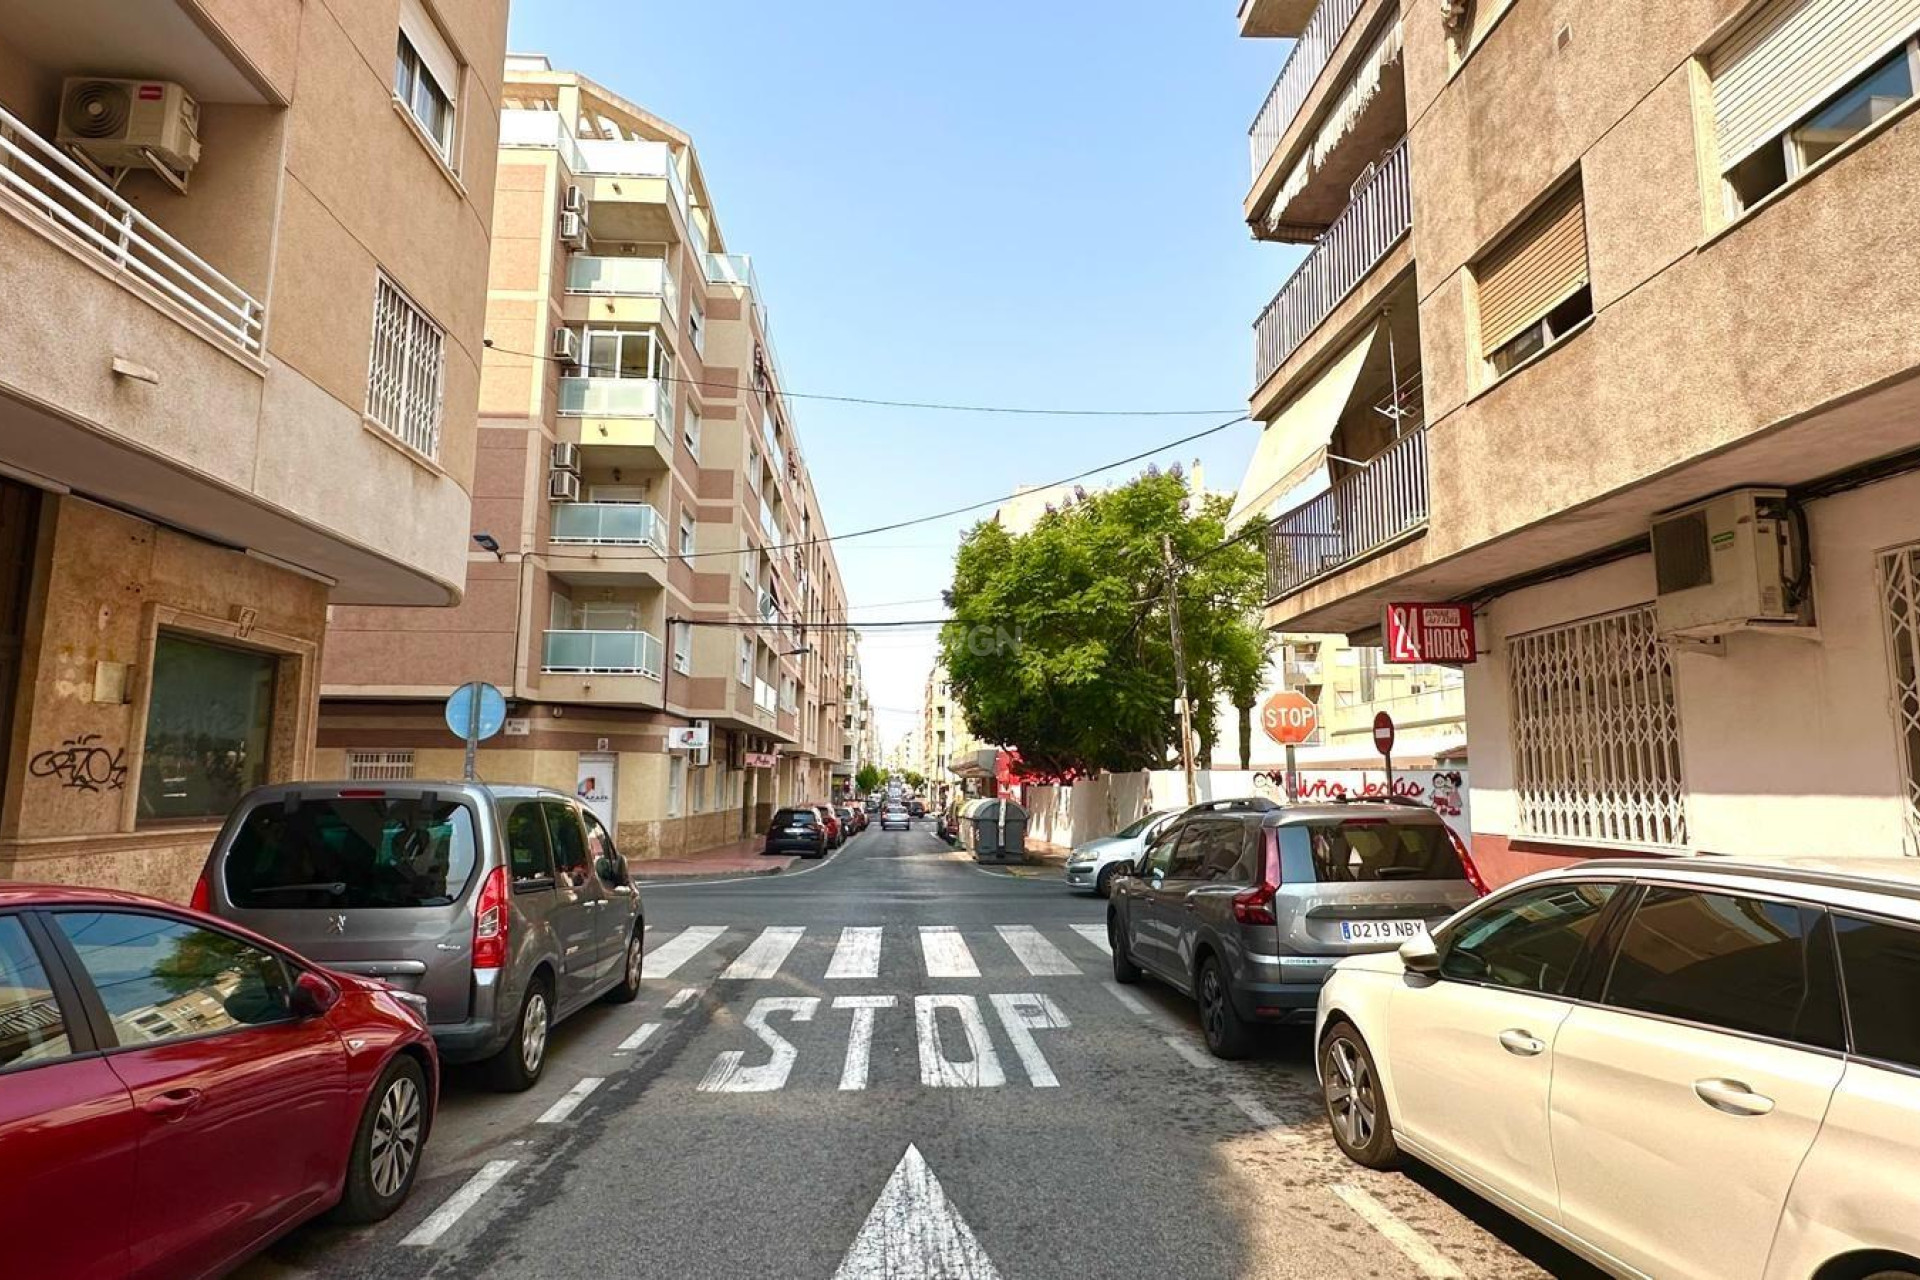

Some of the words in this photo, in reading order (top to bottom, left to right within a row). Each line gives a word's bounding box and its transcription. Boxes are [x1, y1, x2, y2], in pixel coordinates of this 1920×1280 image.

[1393, 606, 1421, 658] 24
[1423, 628, 1469, 659] HORAS
[1265, 706, 1313, 729] STOP
[1352, 922, 1391, 938] 0219
[696, 993, 1072, 1093] STOP
